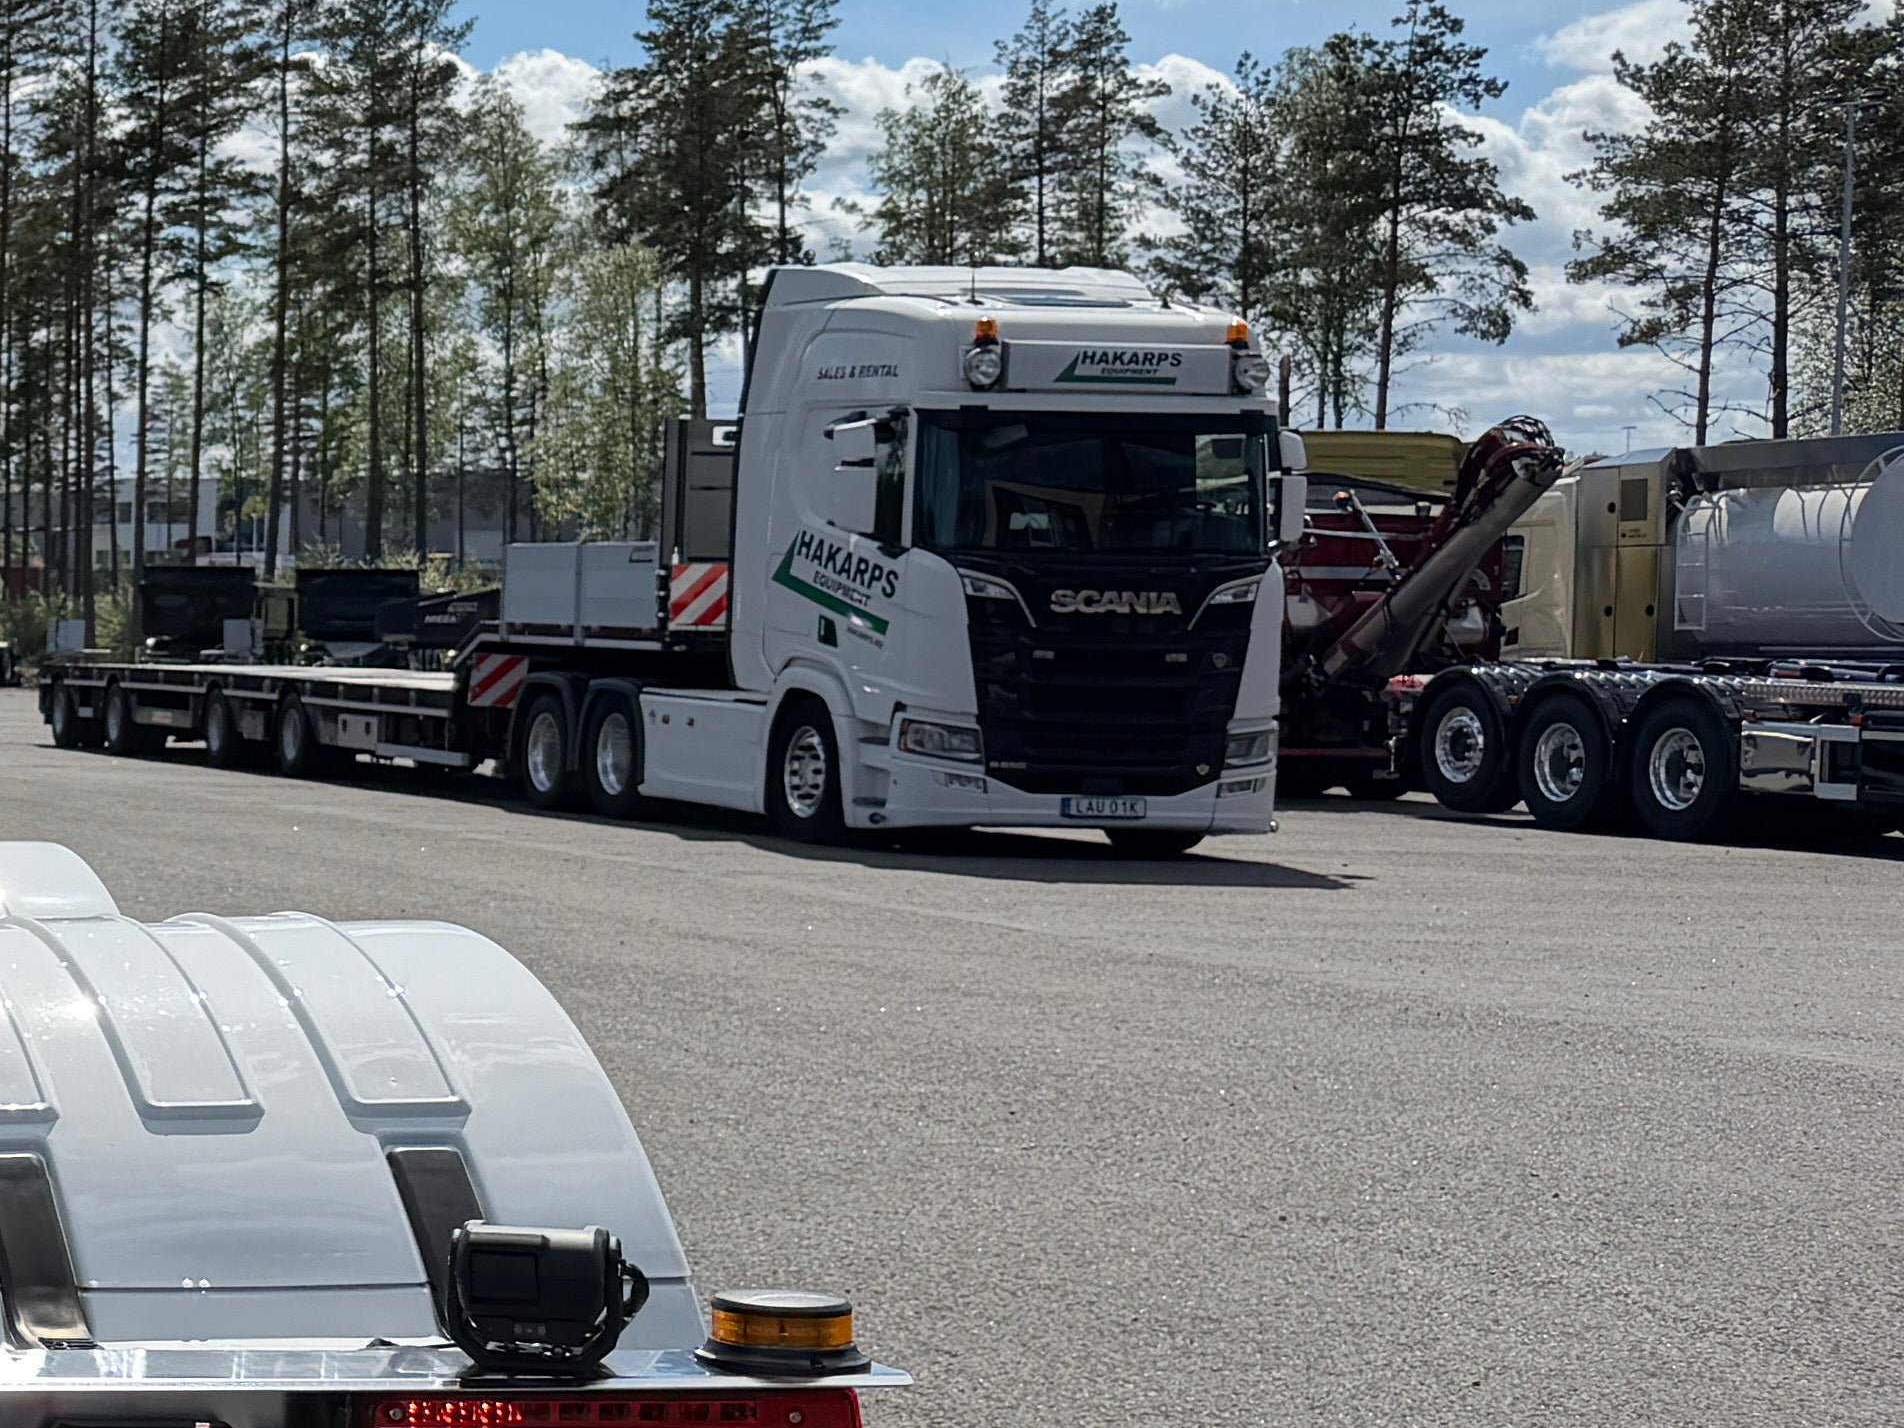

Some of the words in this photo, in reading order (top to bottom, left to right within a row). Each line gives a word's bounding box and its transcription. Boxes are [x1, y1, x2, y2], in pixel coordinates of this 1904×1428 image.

[1081, 350, 1183, 367] HAKARPS
[817, 365, 846, 380] SALES
[858, 364, 899, 378] RENTAL
[796, 530, 899, 599] HAKARPS
[812, 570, 872, 607] EQUIPMENT
[1050, 589, 1182, 615] SCANIA
